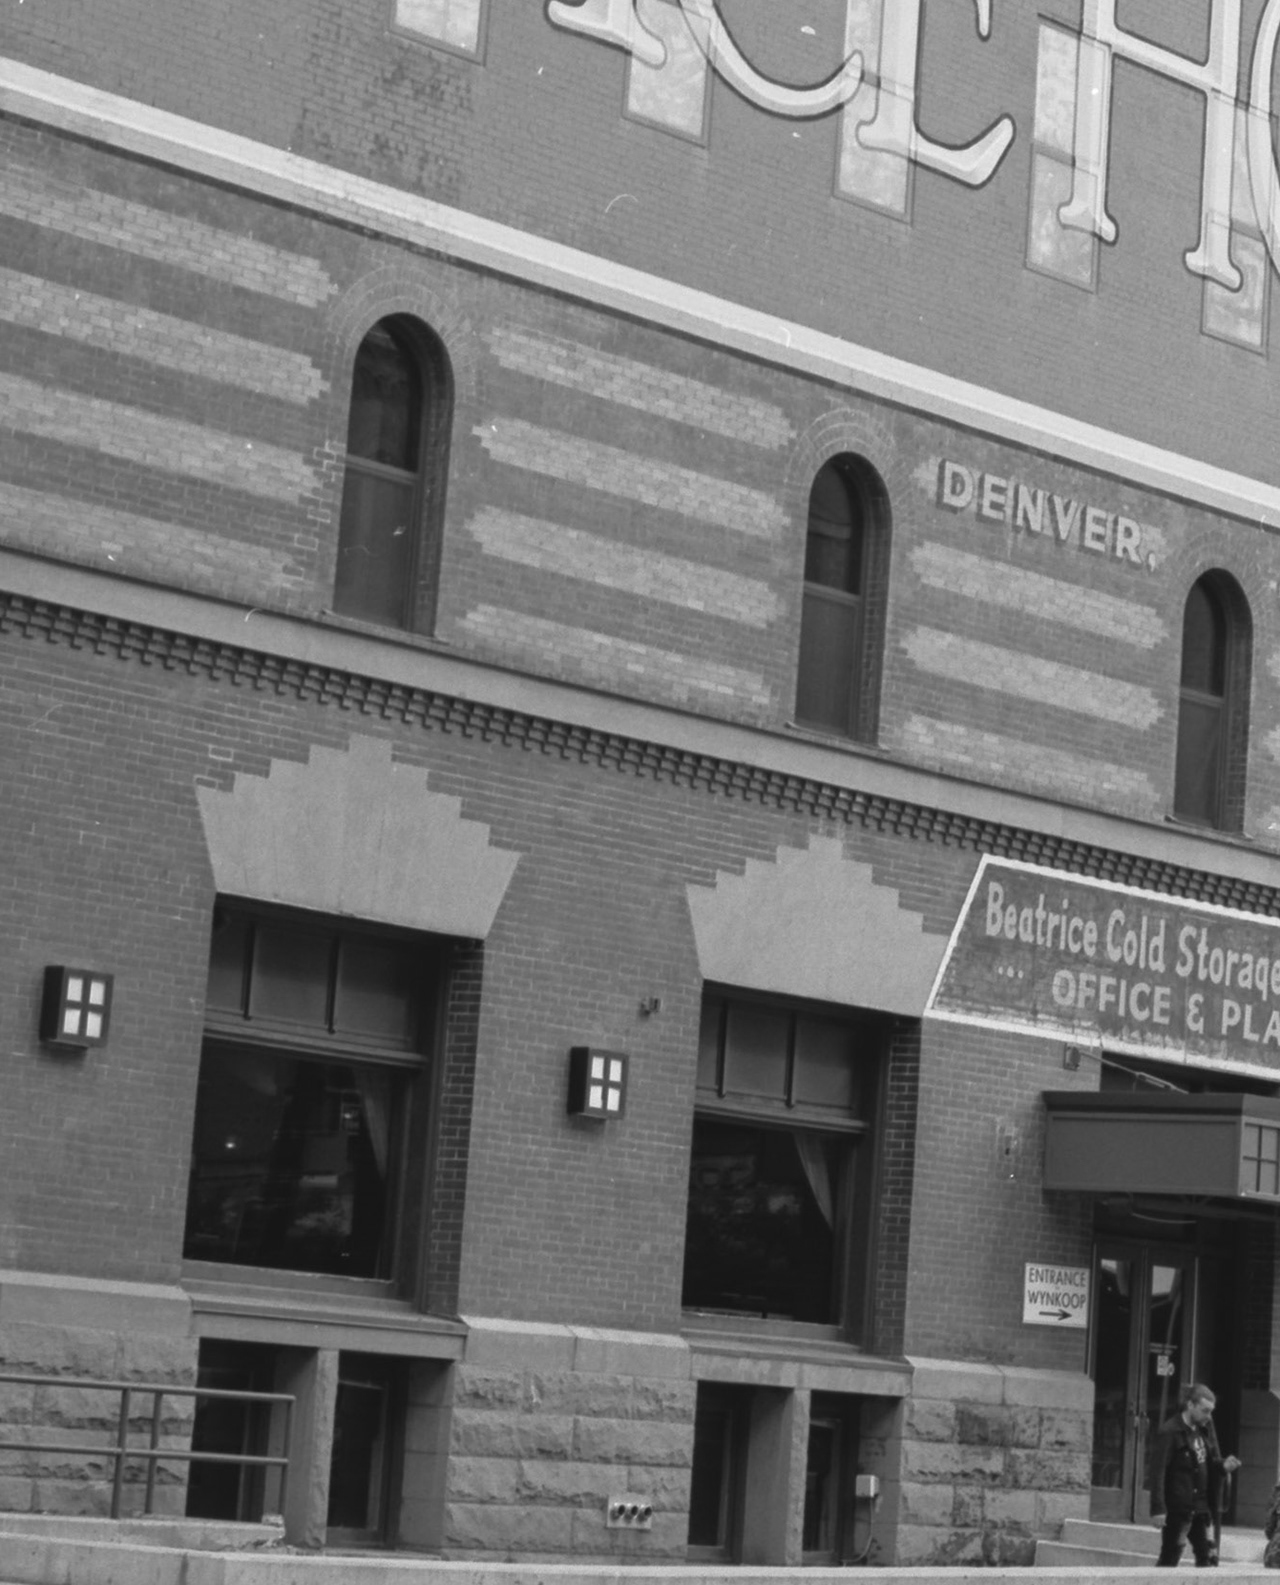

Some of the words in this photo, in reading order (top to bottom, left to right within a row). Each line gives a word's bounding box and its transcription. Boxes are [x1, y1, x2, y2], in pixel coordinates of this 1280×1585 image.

[937, 459, 1157, 572] DENVER,
[985, 881, 1098, 957] Beatrice
[1106, 909, 1166, 973] Cold
[1051, 969, 1171, 1025] OFFICE
[1186, 993, 1205, 1035] &
[1027, 1289, 1087, 1309] WYNKOOP
[1028, 1267, 1086, 1288] ENTRANCE
